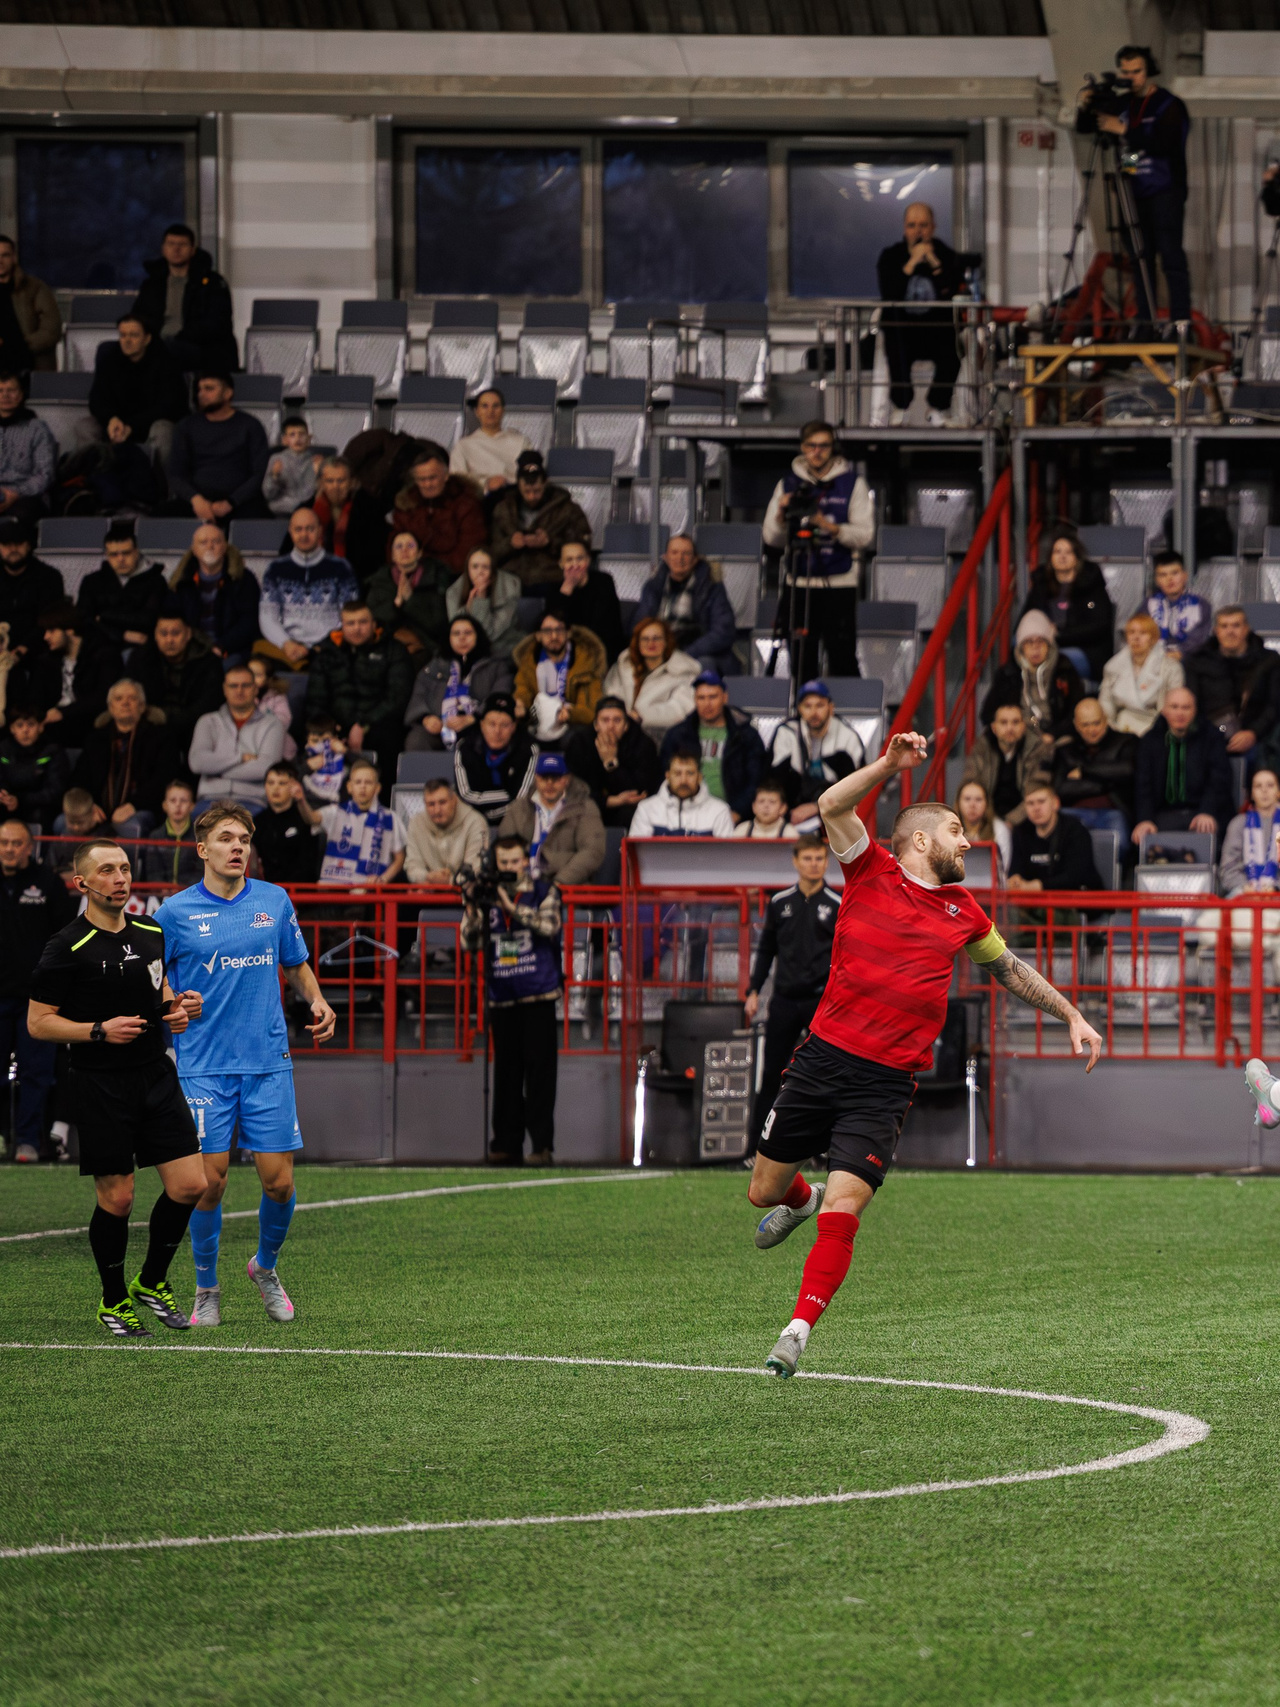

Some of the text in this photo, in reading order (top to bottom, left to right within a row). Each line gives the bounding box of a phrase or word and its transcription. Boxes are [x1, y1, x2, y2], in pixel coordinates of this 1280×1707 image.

[220, 954, 274, 970] Рексона
[761, 1108, 776, 1140] 9
[805, 1293, 827, 1309] JAKO
